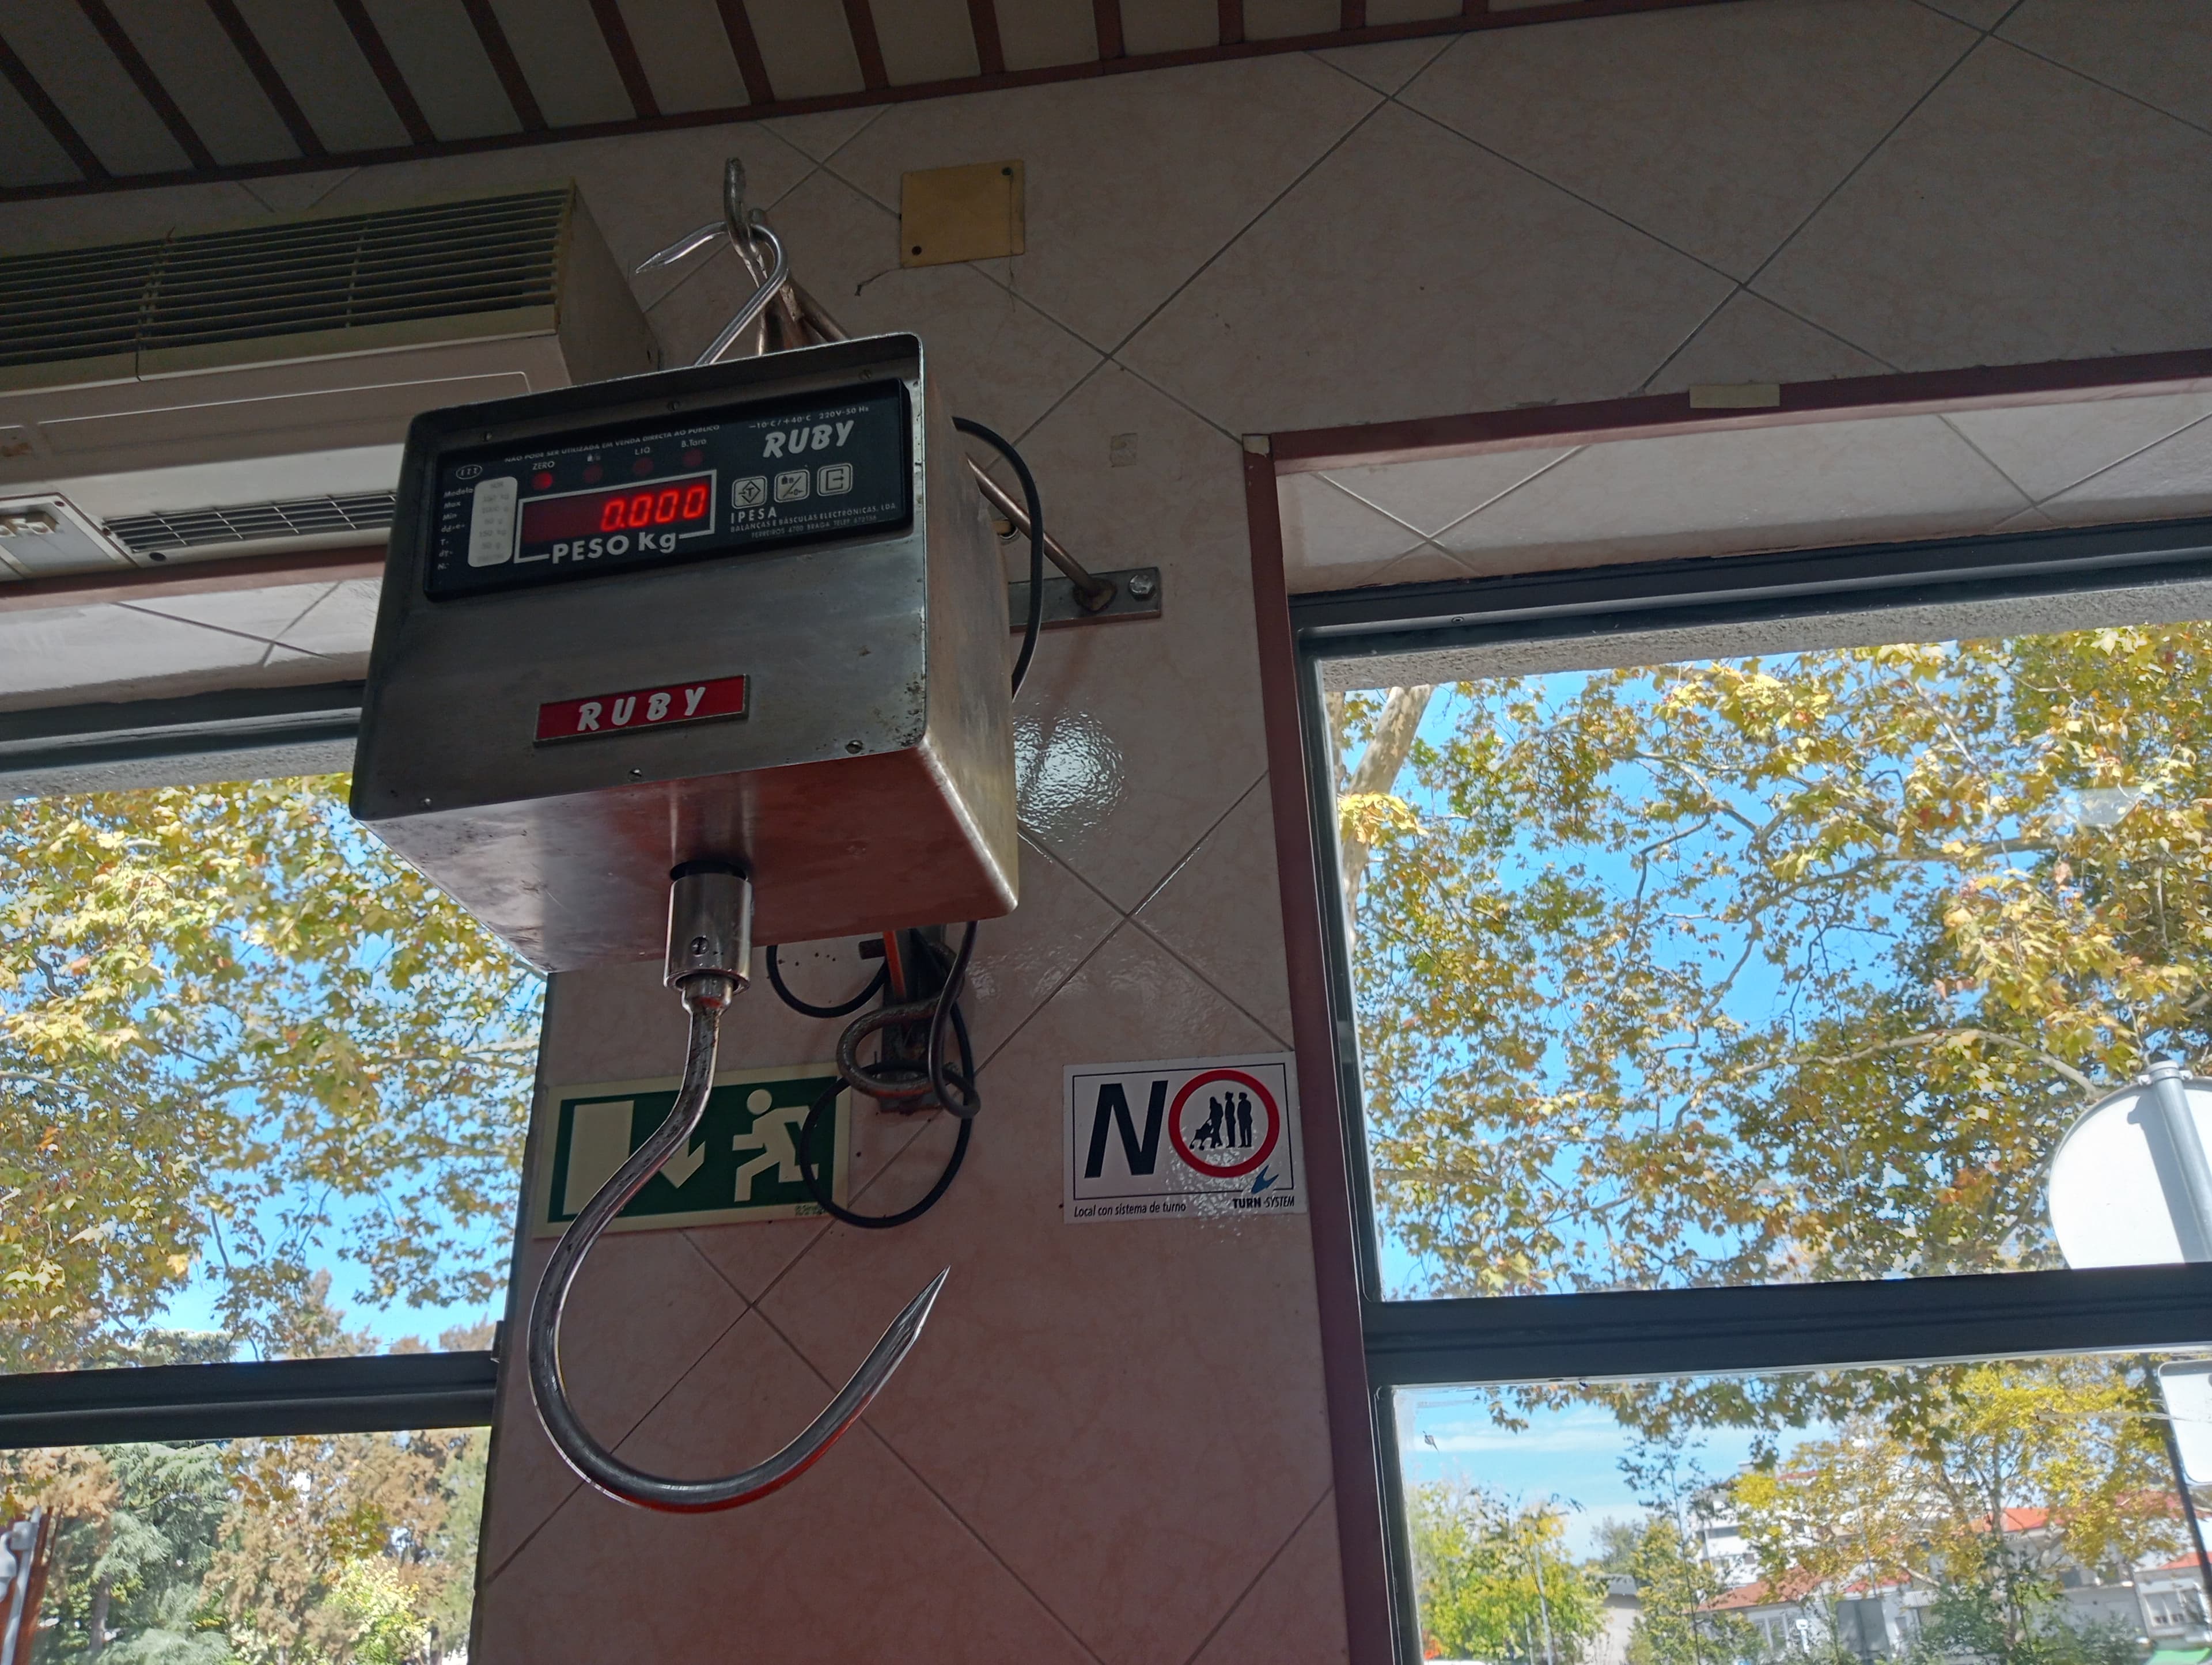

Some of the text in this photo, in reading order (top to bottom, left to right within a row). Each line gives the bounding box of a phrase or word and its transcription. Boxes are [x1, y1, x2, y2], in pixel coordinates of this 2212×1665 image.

[546, 449, 559, 457] SER
[562, 443, 600, 455] UTILIZADA
[602, 441, 614, 449] EM
[615, 437, 641, 447] VENDA
[643, 431, 673, 443] DIRECTA
[762, 419, 854, 458] RUBY
[532, 461, 555, 471] ZERO
[443, 487, 474, 498] Modelo
[600, 485, 708, 532] 0.000
[730, 506, 777, 524] IPESA
[552, 532, 676, 564] PESO Kg
[576, 686, 706, 732] RUBY
[1073, 1201, 1187, 1218] Local con sistema de turno
[1232, 1196, 1294, 1208] TURN SYSTEM
